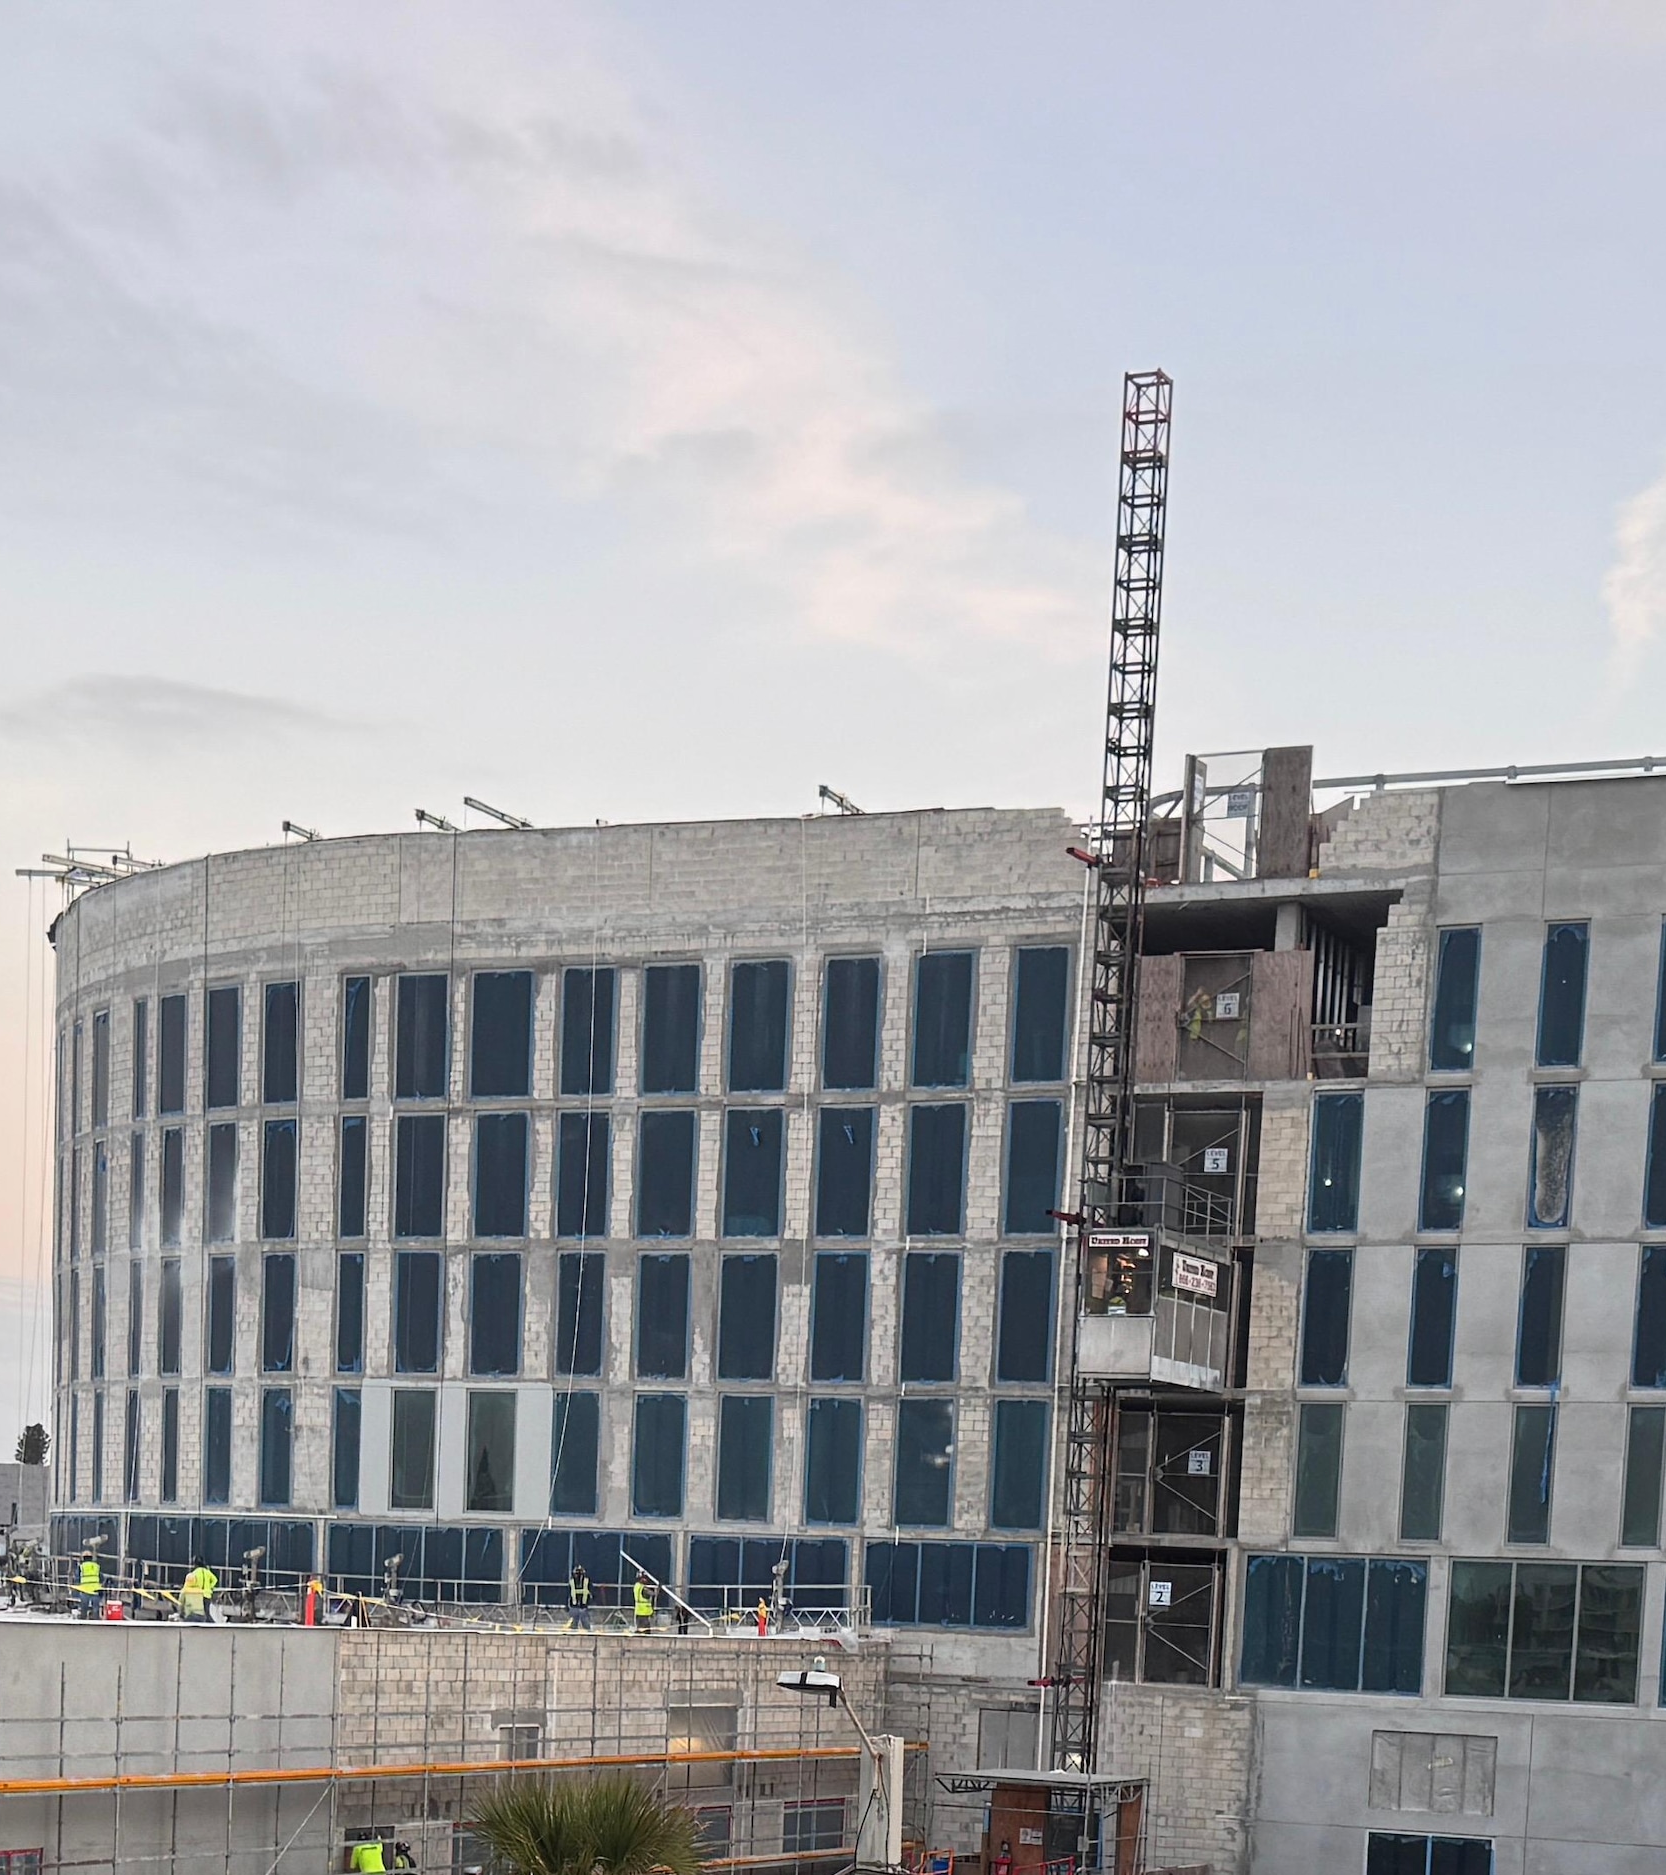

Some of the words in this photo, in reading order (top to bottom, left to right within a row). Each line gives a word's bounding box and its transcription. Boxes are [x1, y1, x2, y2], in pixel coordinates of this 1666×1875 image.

[1224, 1002, 1232, 1015] 6
[1212, 1158, 1220, 1170] 5
[1195, 1460, 1203, 1472] 3
[1156, 1591, 1164, 1602] 2
